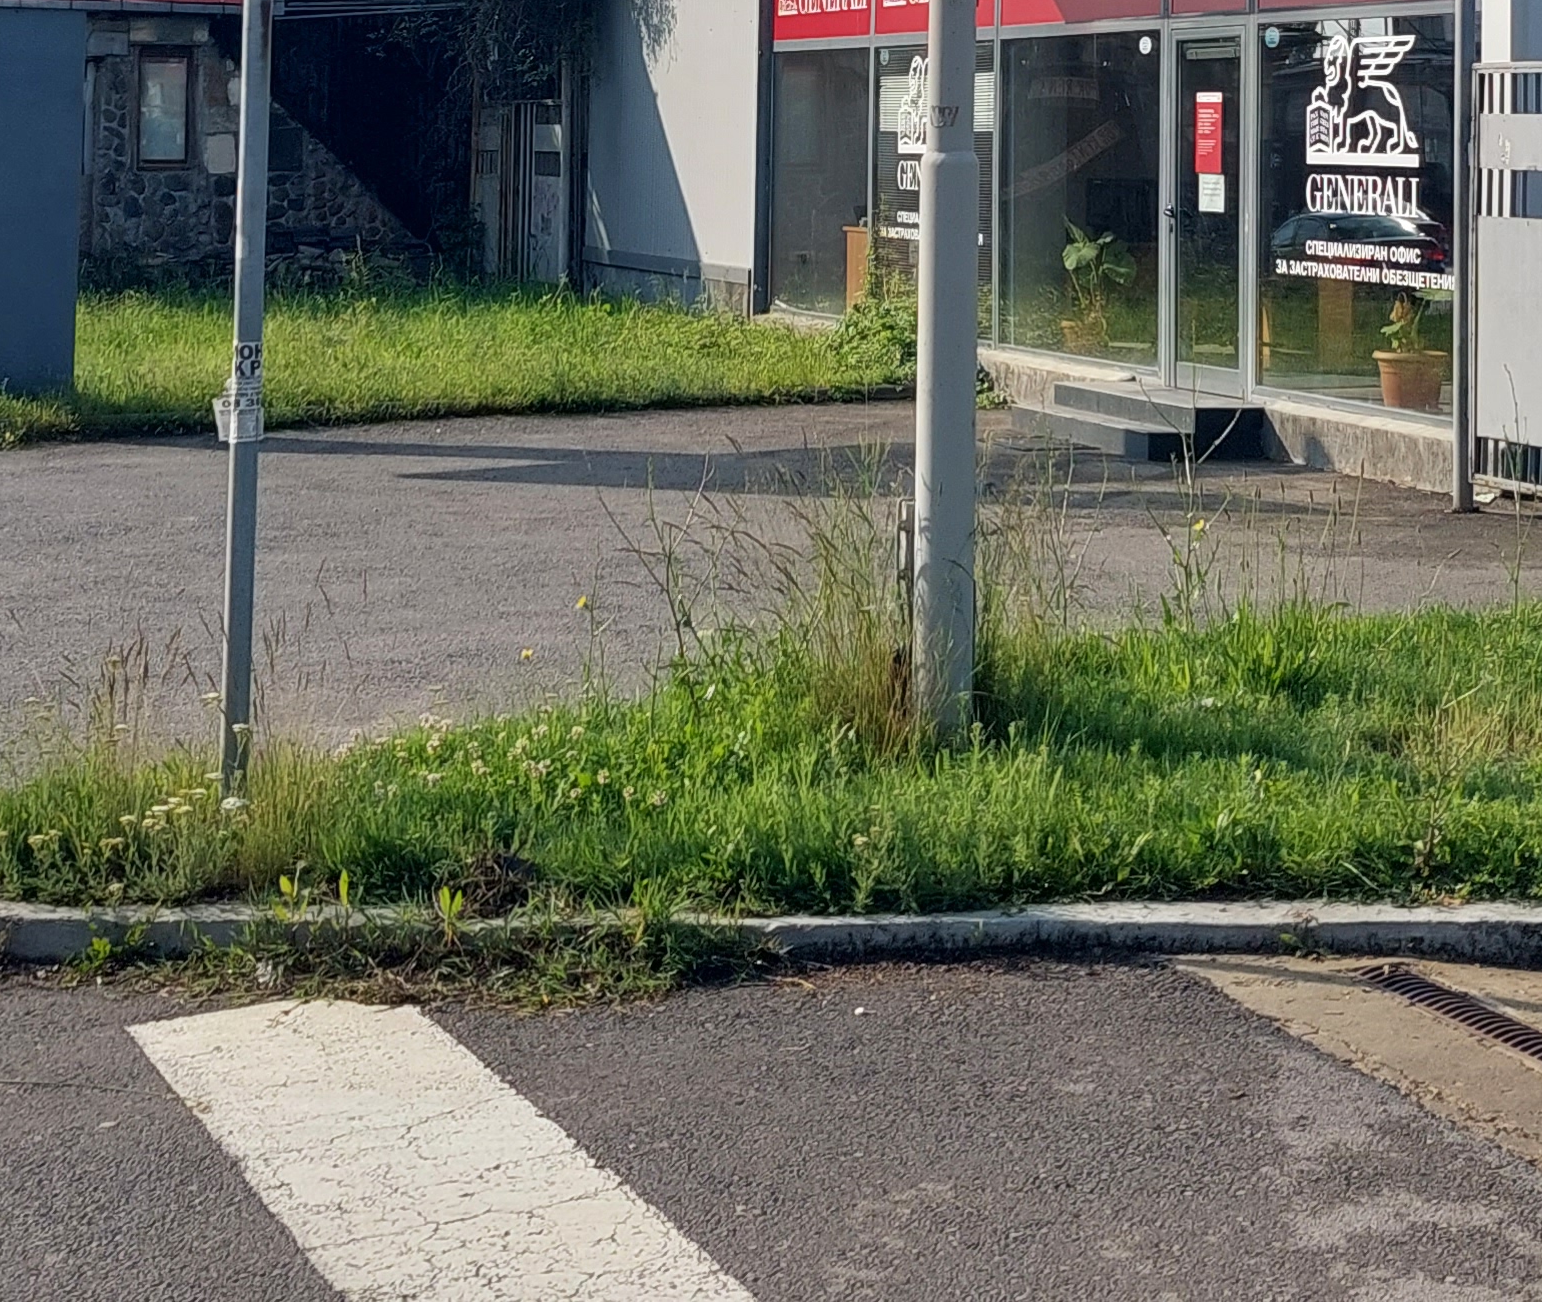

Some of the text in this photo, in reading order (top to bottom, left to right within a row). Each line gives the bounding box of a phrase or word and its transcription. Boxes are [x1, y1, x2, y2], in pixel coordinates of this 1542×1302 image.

[1306, 173, 1420, 218] GENERALI
[1305, 240, 1422, 265] СПЕЦИАЛИЗИРАН ОФИС
[1275, 259, 1288, 275] ЗА
[1289, 260, 1380, 284] ЗАСТРАХОВАТЕЛНИ
